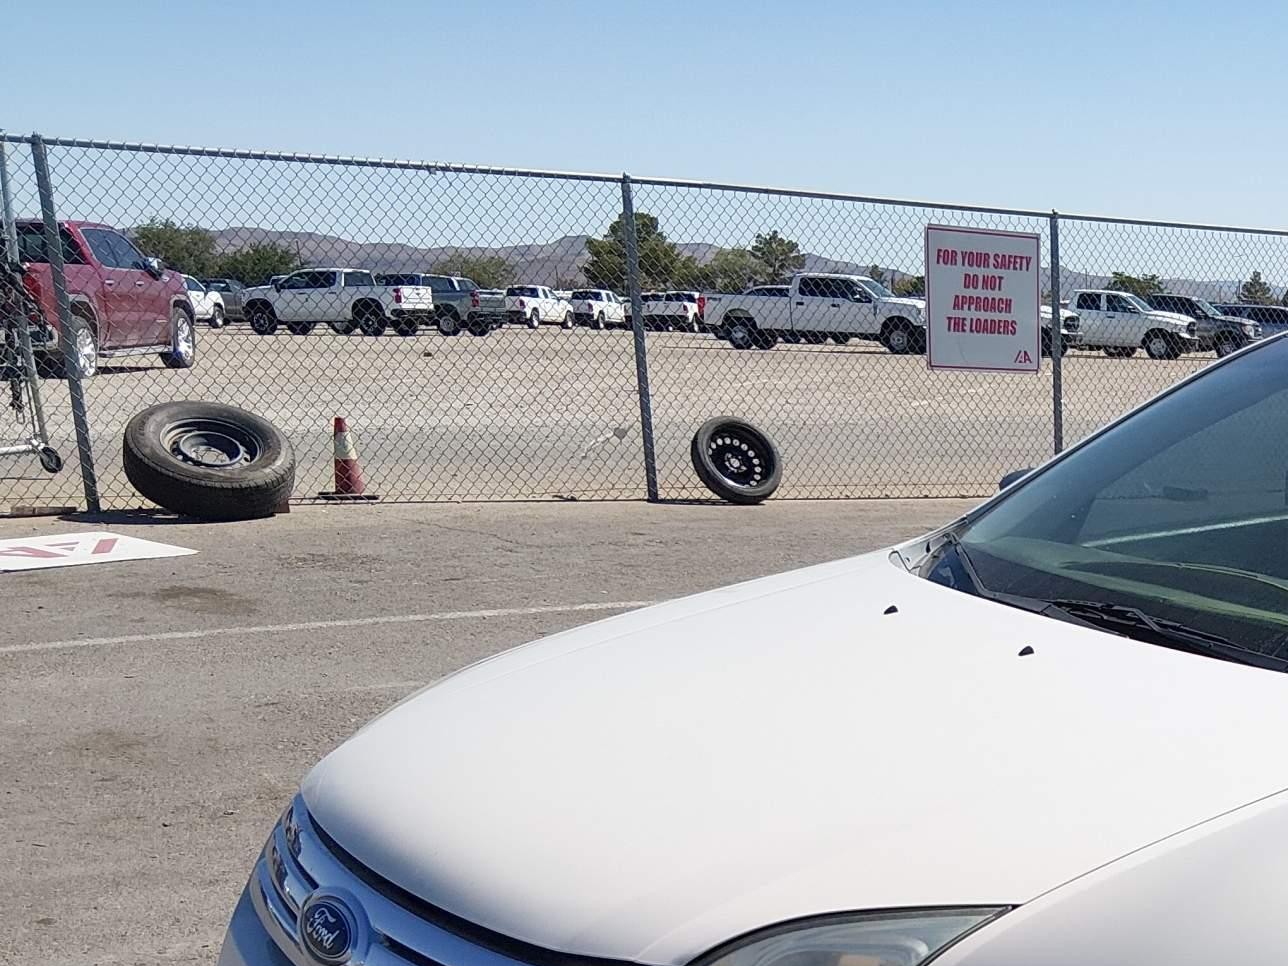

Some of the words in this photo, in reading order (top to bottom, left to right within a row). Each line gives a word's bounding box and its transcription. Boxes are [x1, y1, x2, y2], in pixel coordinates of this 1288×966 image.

[936, 249, 958, 266] FOR
[960, 250, 991, 269] YOUR
[992, 253, 1033, 272] SAFETY
[963, 273, 979, 290] DO
[981, 275, 1004, 291] NOT
[952, 295, 1012, 313] APPROACH
[946, 316, 967, 333] THE
[969, 317, 1018, 336] LOADERS
[307, 907, 340, 949] Ford
